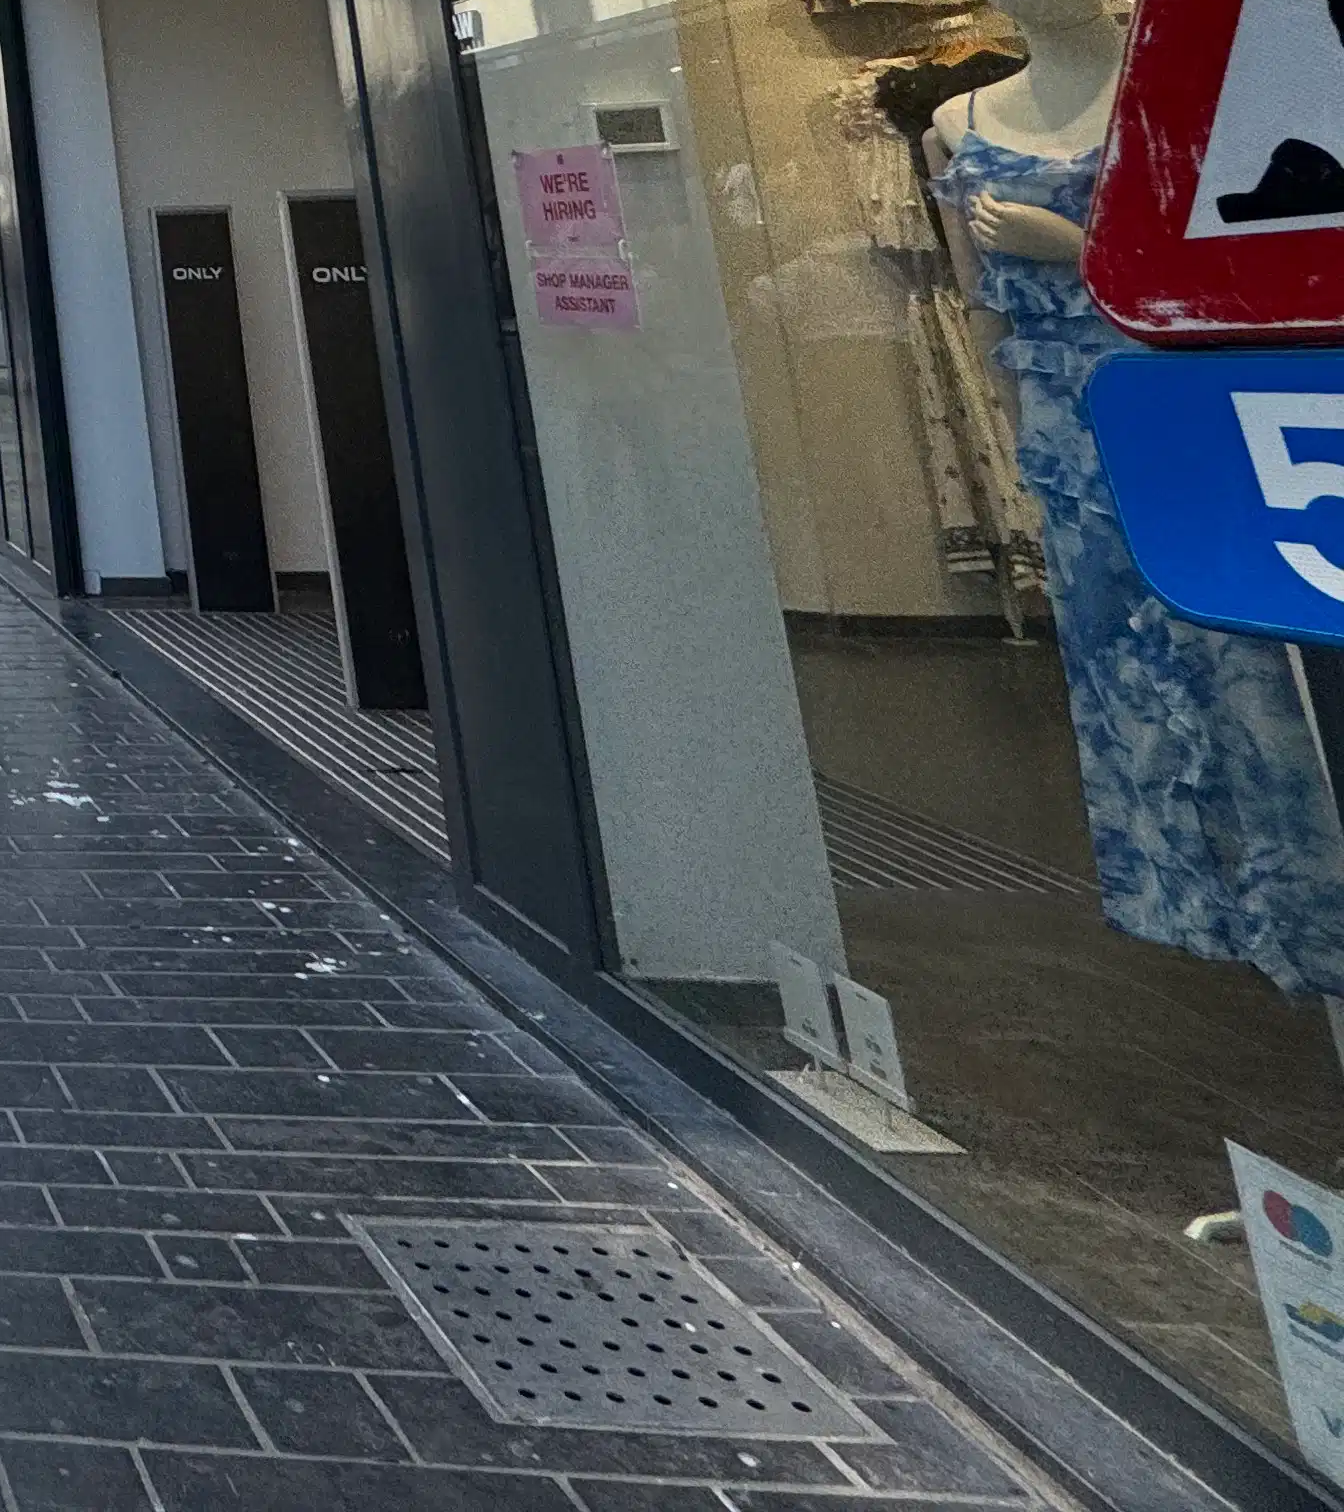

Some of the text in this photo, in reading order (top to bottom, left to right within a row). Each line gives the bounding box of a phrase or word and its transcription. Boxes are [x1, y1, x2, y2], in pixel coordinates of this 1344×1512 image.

[540, 172, 590, 194] WE'RE
[543, 199, 597, 220] HIRING
[172, 266, 223, 281] ONLY
[536, 272, 630, 290] SHOP MANAGER
[555, 295, 616, 314] ASSISTANT
[1230, 392, 1344, 603] 5
